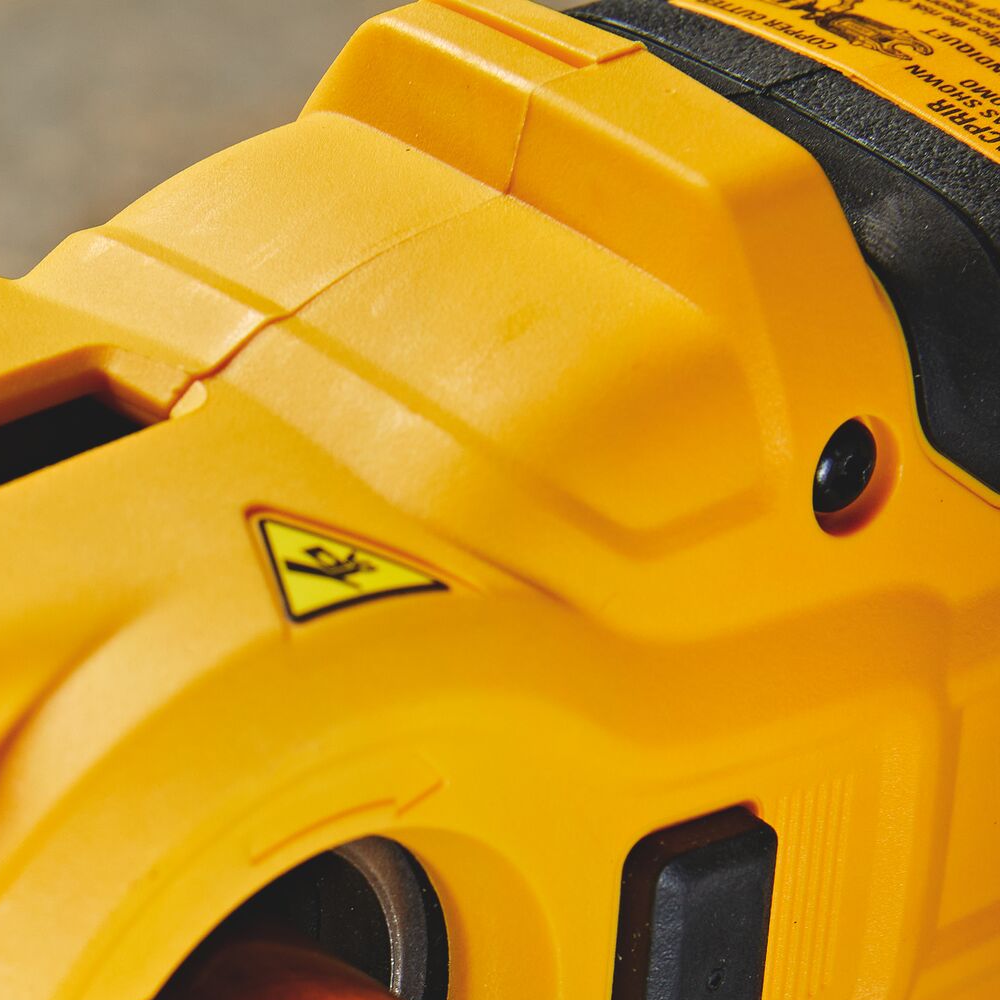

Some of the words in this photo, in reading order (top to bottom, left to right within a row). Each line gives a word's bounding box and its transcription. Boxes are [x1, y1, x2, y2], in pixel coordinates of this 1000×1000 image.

[698, 0, 766, 21] CUTTE
[764, 19, 837, 50] COPPER
[904, 64, 983, 108] SHOWN
